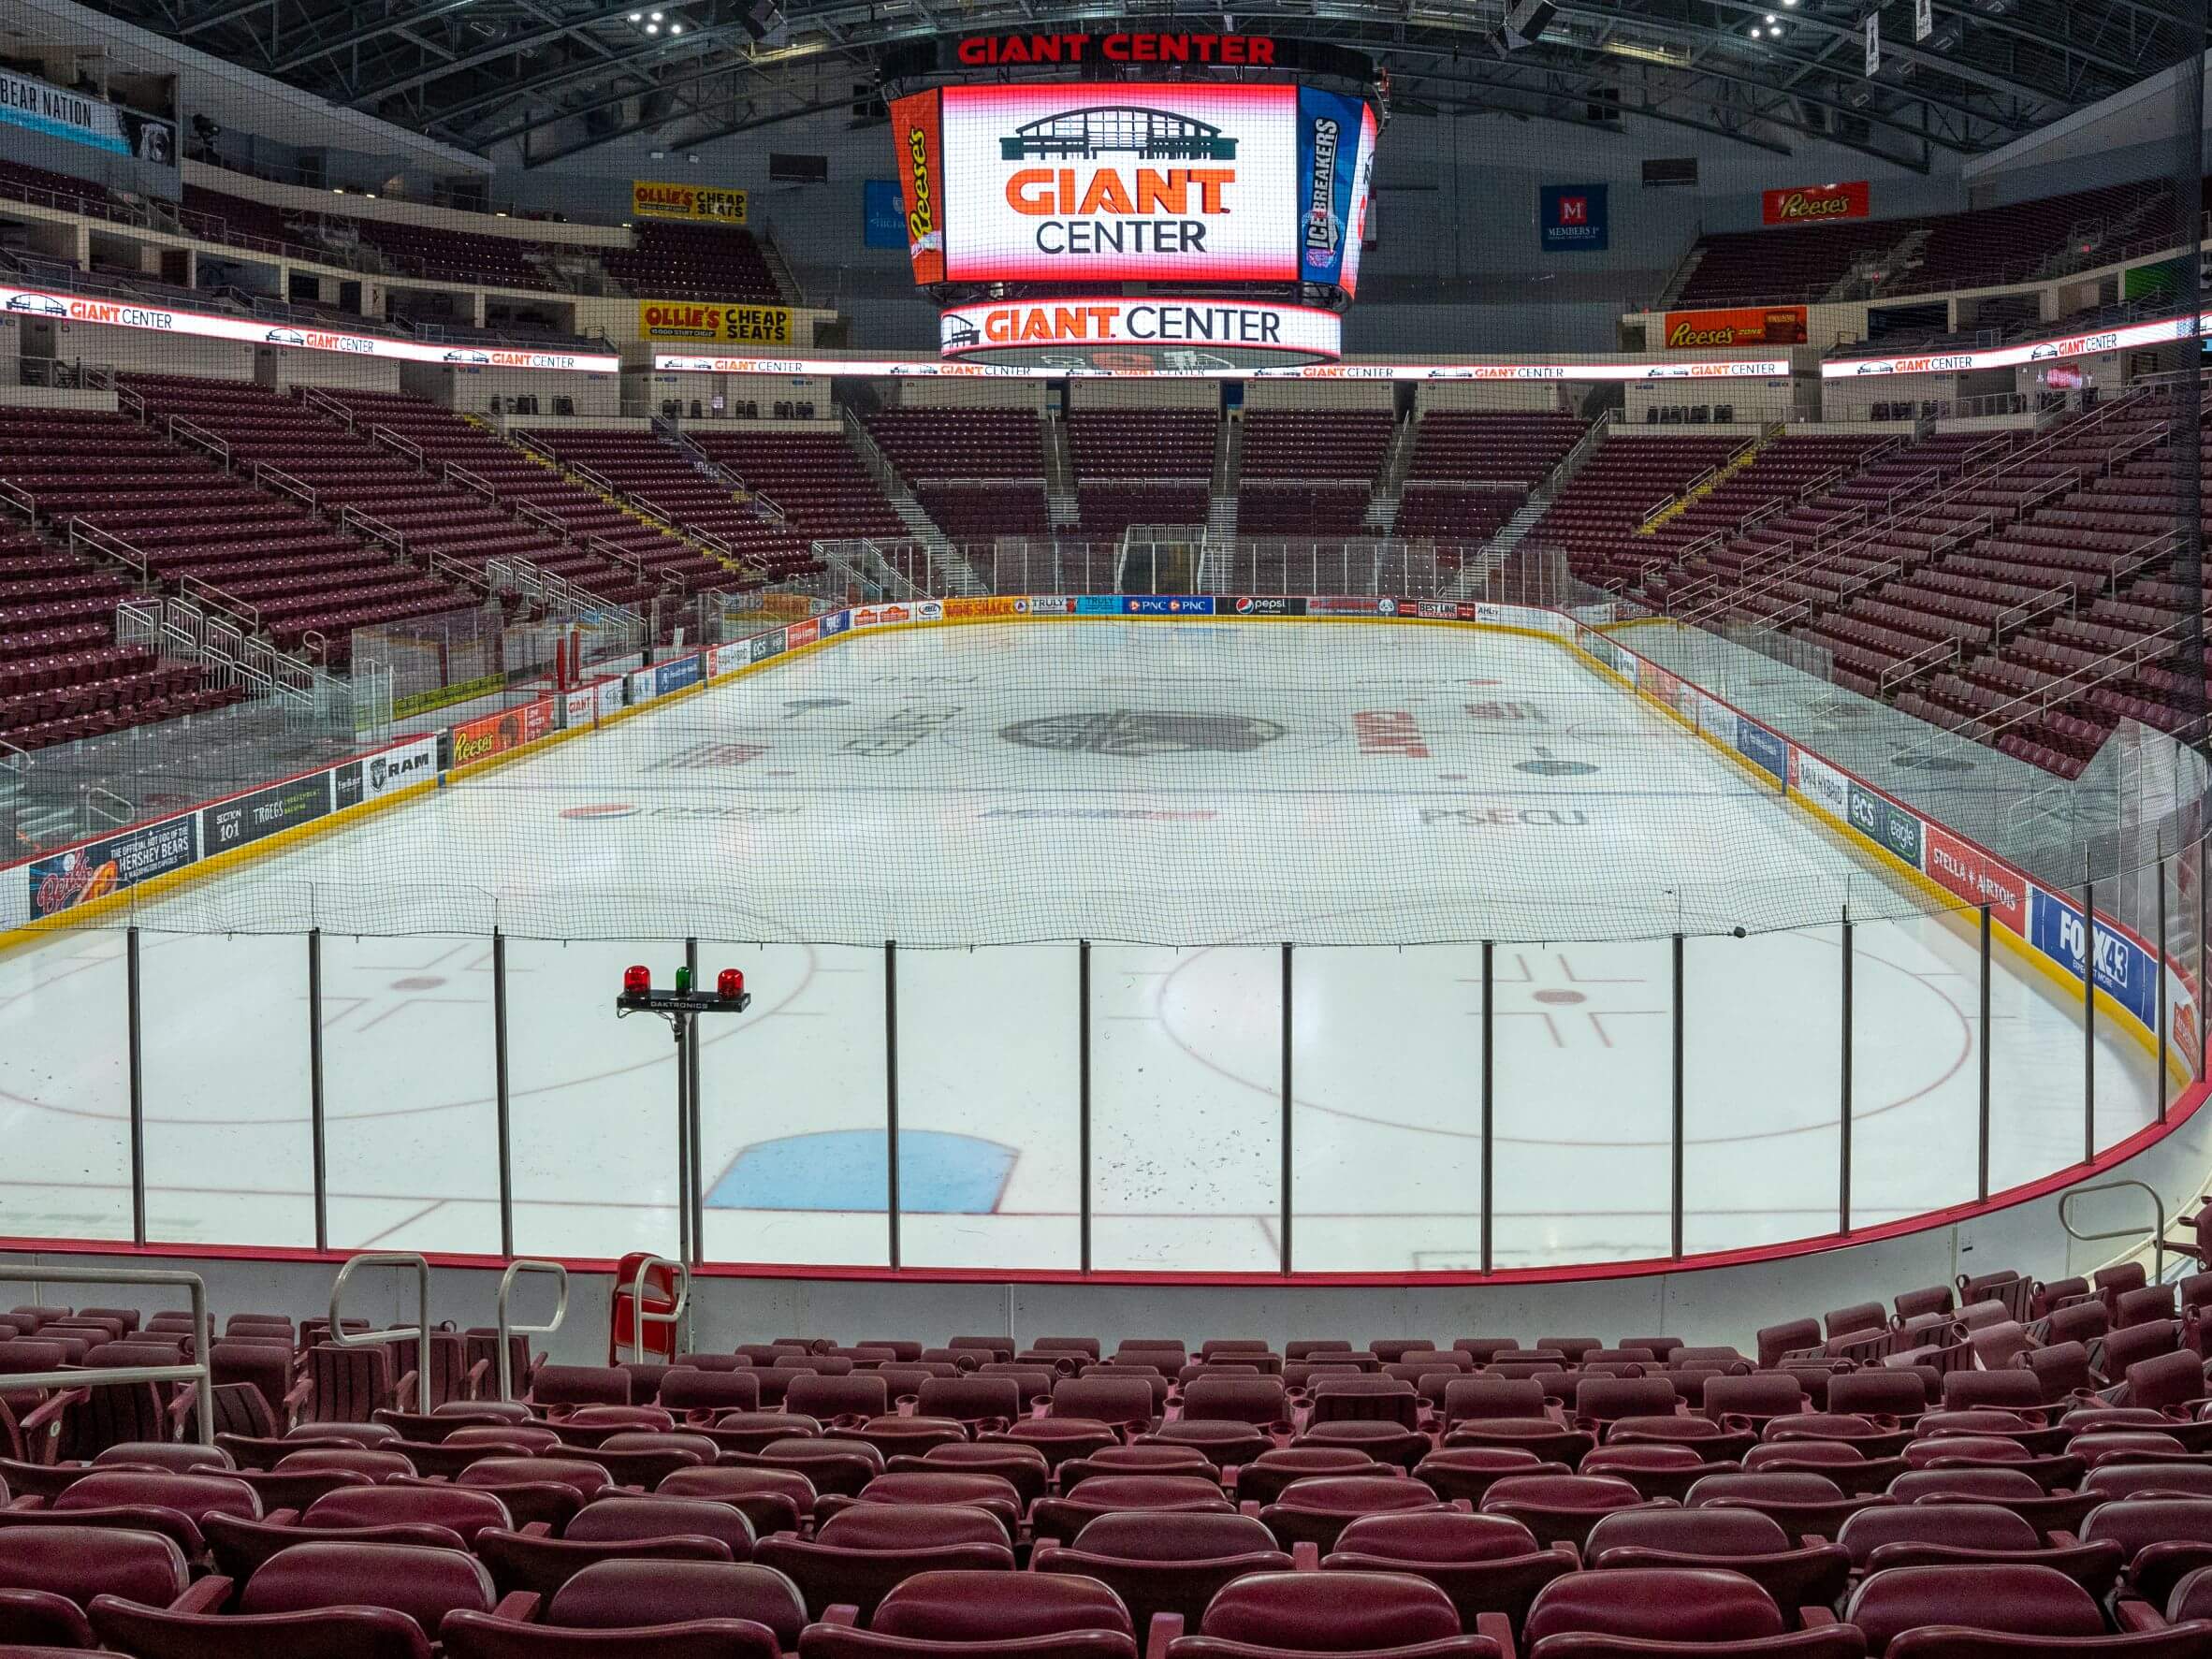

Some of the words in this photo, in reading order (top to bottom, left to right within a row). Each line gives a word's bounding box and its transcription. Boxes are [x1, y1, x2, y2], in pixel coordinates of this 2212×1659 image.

[957, 34, 1089, 65] GIANT
[1102, 34, 1274, 65] CENTER
[1, 78, 36, 112] BEAR
[43, 91, 92, 127] NATION
[1313, 118, 1338, 212] BREAKERS
[909, 125, 933, 241] Reese's
[1005, 168, 1236, 215] GIANT
[696, 192, 745, 206] CHEAP
[1780, 193, 1850, 218] Reese's
[697, 204, 744, 218] SEATS
[1564, 202, 1581, 219] M
[1036, 221, 1206, 254] CENTER
[1306, 213, 1329, 248] ICE
[1549, 226, 1591, 236] MEMBERS
[70, 301, 120, 323] GIANT
[123, 309, 172, 328] CENTER
[725, 309, 787, 326] CHEAP
[727, 325, 785, 341] SEATS
[985, 307, 1120, 342] GIANT
[1127, 307, 1280, 343] CENTER
[1669, 322, 1735, 346] Reese's
[307, 333, 340, 350] GIANT
[341, 338, 374, 353] CENTER
[2059, 340, 2087, 355] GIANT
[2087, 333, 2117, 351] CENTER
[491, 353, 531, 366] GIANT
[532, 355, 575, 368] CENTER
[715, 360, 756, 371] GIANT
[758, 361, 803, 372] CENTER
[1691, 365, 1730, 375] GIANT
[1731, 363, 1776, 375] CENTER
[1895, 359, 1930, 372] GIANT
[1931, 356, 1972, 371] CENTER
[1302, 367, 1346, 377] GIANT
[1346, 368, 1393, 377] CENTER
[1475, 368, 1517, 377] GIANT
[1518, 368, 1564, 378] CENTER
[1033, 599, 1064, 607] TRULY
[1142, 601, 1168, 610] PNC
[1182, 601, 1205, 611] PNC
[1255, 598, 1286, 609] pepsi
[1419, 603, 1438, 612] BEST
[1439, 604, 1456, 614] LINE
[568, 696, 591, 714] GIANT
[456, 733, 493, 762] Reese's
[387, 752, 429, 778] RAM
[1817, 772, 1842, 805] HYBRID
[216, 808, 241, 825] SECTION
[1421, 808, 1590, 825] PSECU
[220, 820, 240, 842] 101
[1890, 819, 1914, 849] eagle
[110, 848, 122, 859] THE
[123, 840, 147, 855] OFFICIAL
[147, 836, 158, 847] HOT
[159, 832, 170, 843] DOG
[170, 829, 178, 838] OF
[119, 845, 160, 872] HERSHEY
[161, 836, 189, 857] BEARS
[1933, 847, 1967, 881] STELLA
[1976, 876, 2016, 912] ARTOIS
[650, 1001, 708, 1010] DAKTRONICS
